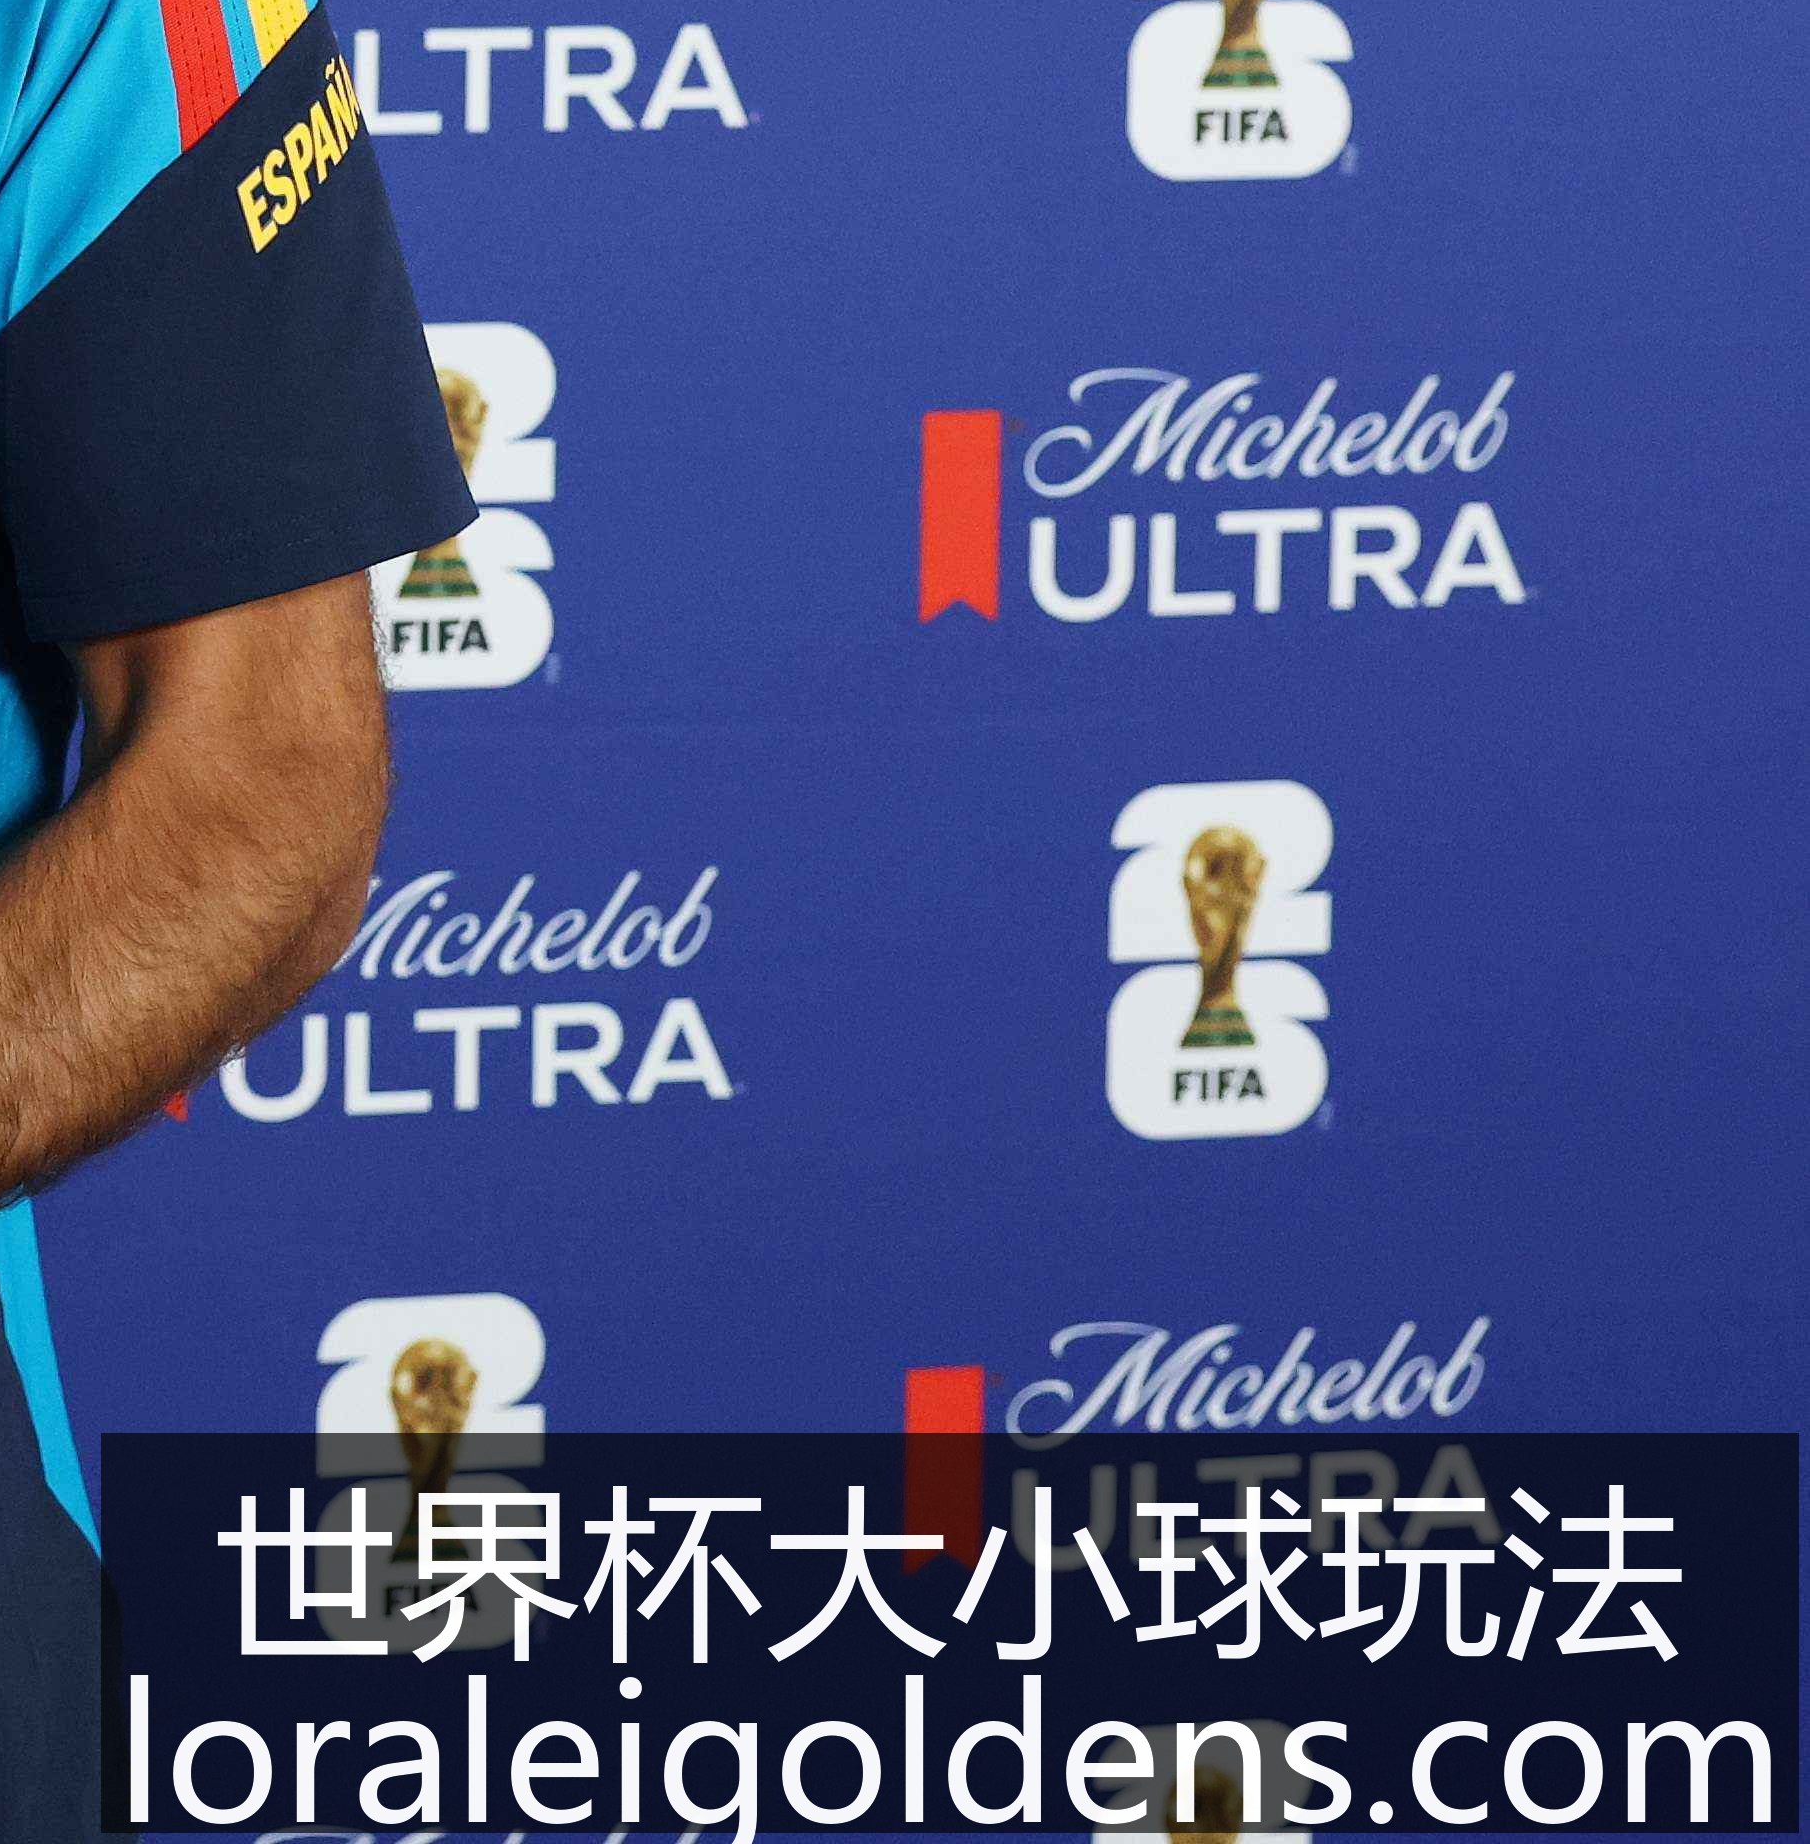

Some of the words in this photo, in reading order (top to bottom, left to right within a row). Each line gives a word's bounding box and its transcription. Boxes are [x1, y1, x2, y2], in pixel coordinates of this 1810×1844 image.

[352, 24, 749, 136] LTRA
[1195, 109, 1287, 142] FIFA
[1028, 368, 1514, 497] Michelob
[1030, 504, 1525, 621] ULTRA
[391, 619, 489, 654] FIFA
[218, 998, 734, 1123] ULTRA
[1173, 1068, 1264, 1101] FIFA
[1007, 1316, 1490, 1450] Michelob
